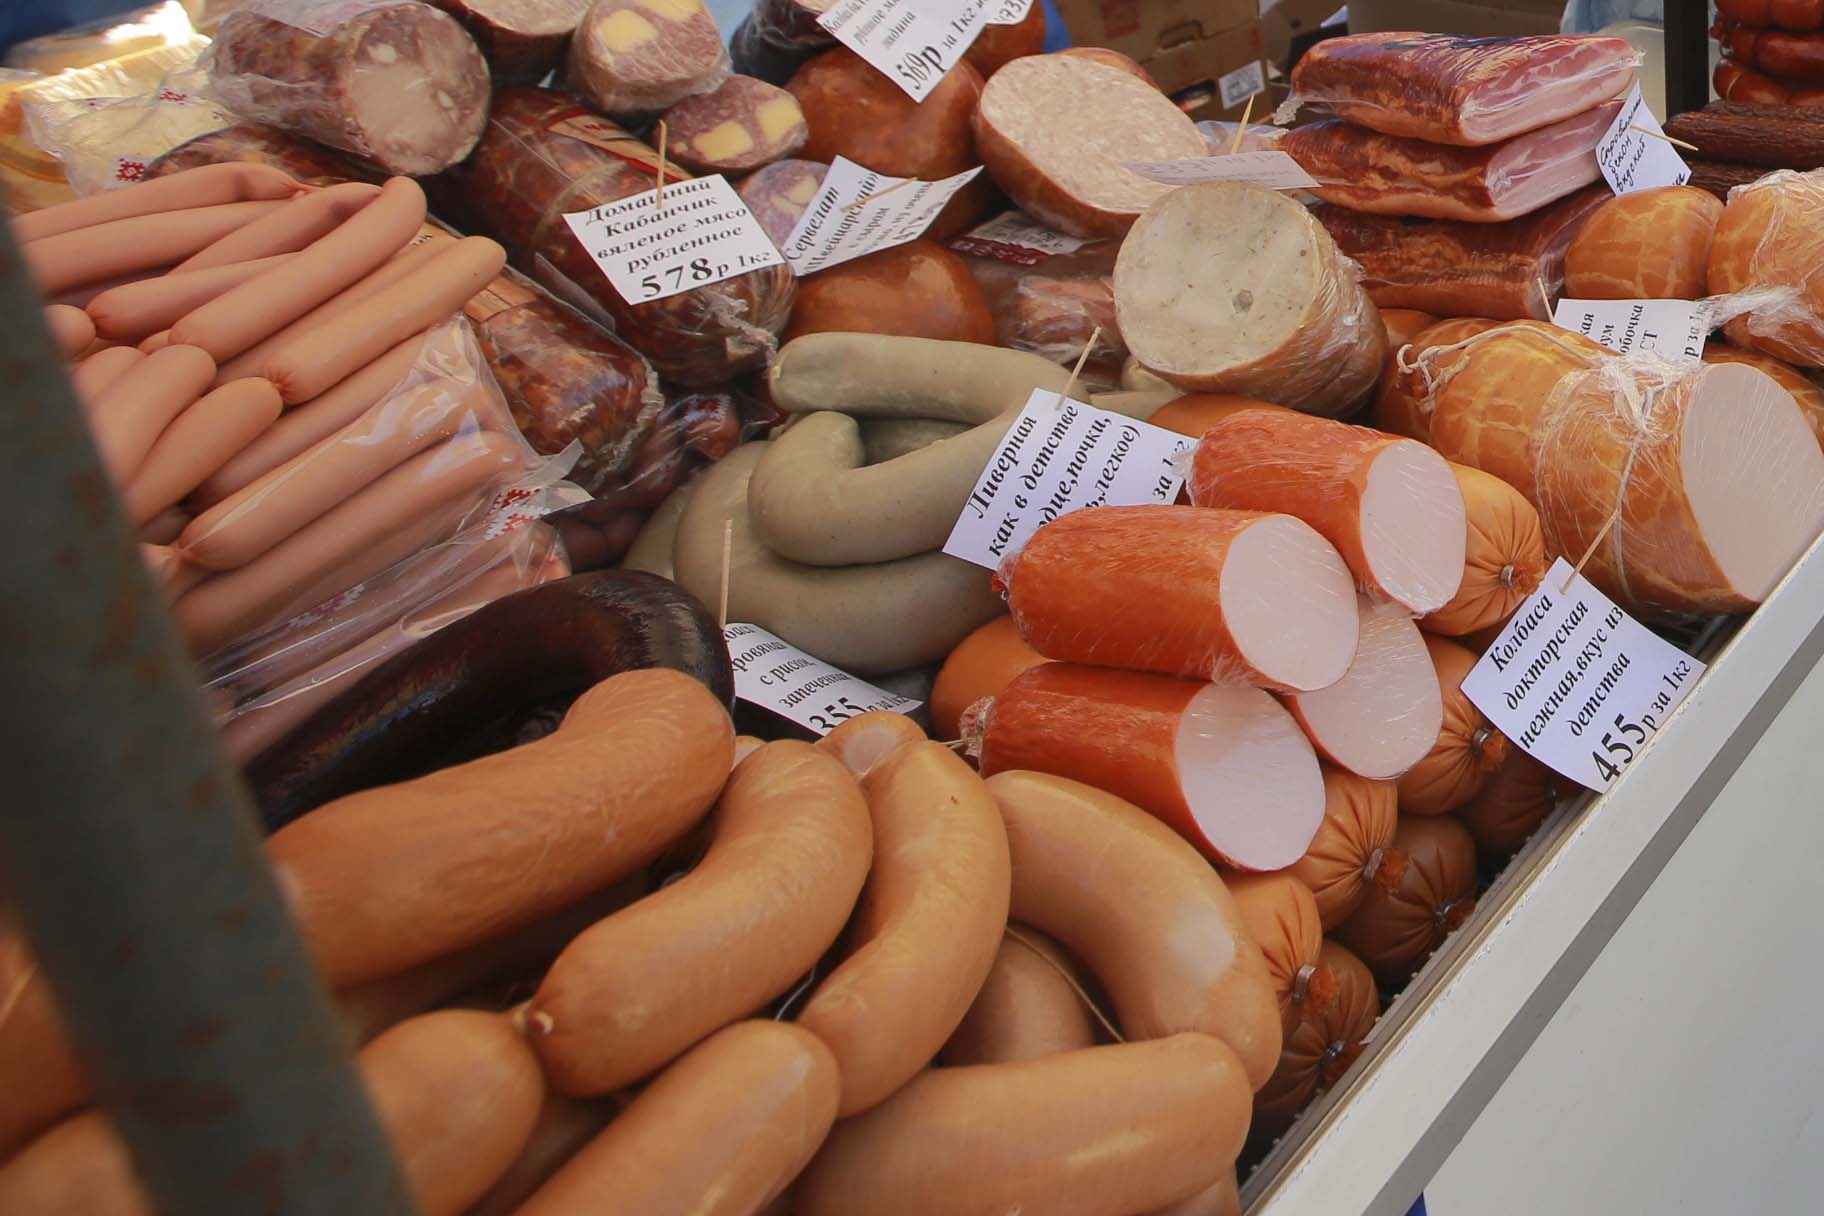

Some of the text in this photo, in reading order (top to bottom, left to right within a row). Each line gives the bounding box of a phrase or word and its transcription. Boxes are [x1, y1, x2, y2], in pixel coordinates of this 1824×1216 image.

[956, 8, 977, 33] 1кг
[597, 208, 747, 259] вяленое мясо
[605, 197, 717, 237] Кабанчик
[786, 186, 840, 261] Сервелат
[627, 226, 743, 274] рубленное
[737, 252, 771, 268] 1кг
[967, 416, 1039, 519] Ливерная
[989, 404, 1080, 556] как в детстве
[1152, 474, 1172, 501] за
[1488, 593, 1553, 673] Колбаса
[1502, 600, 1589, 711] докторская
[759, 674, 774, 686] с
[1519, 606, 1624, 750] нежная,вкус из
[1568, 652, 1631, 738] детства
[1662, 659, 1692, 691] 1кг
[1656, 690, 1672, 714] за
